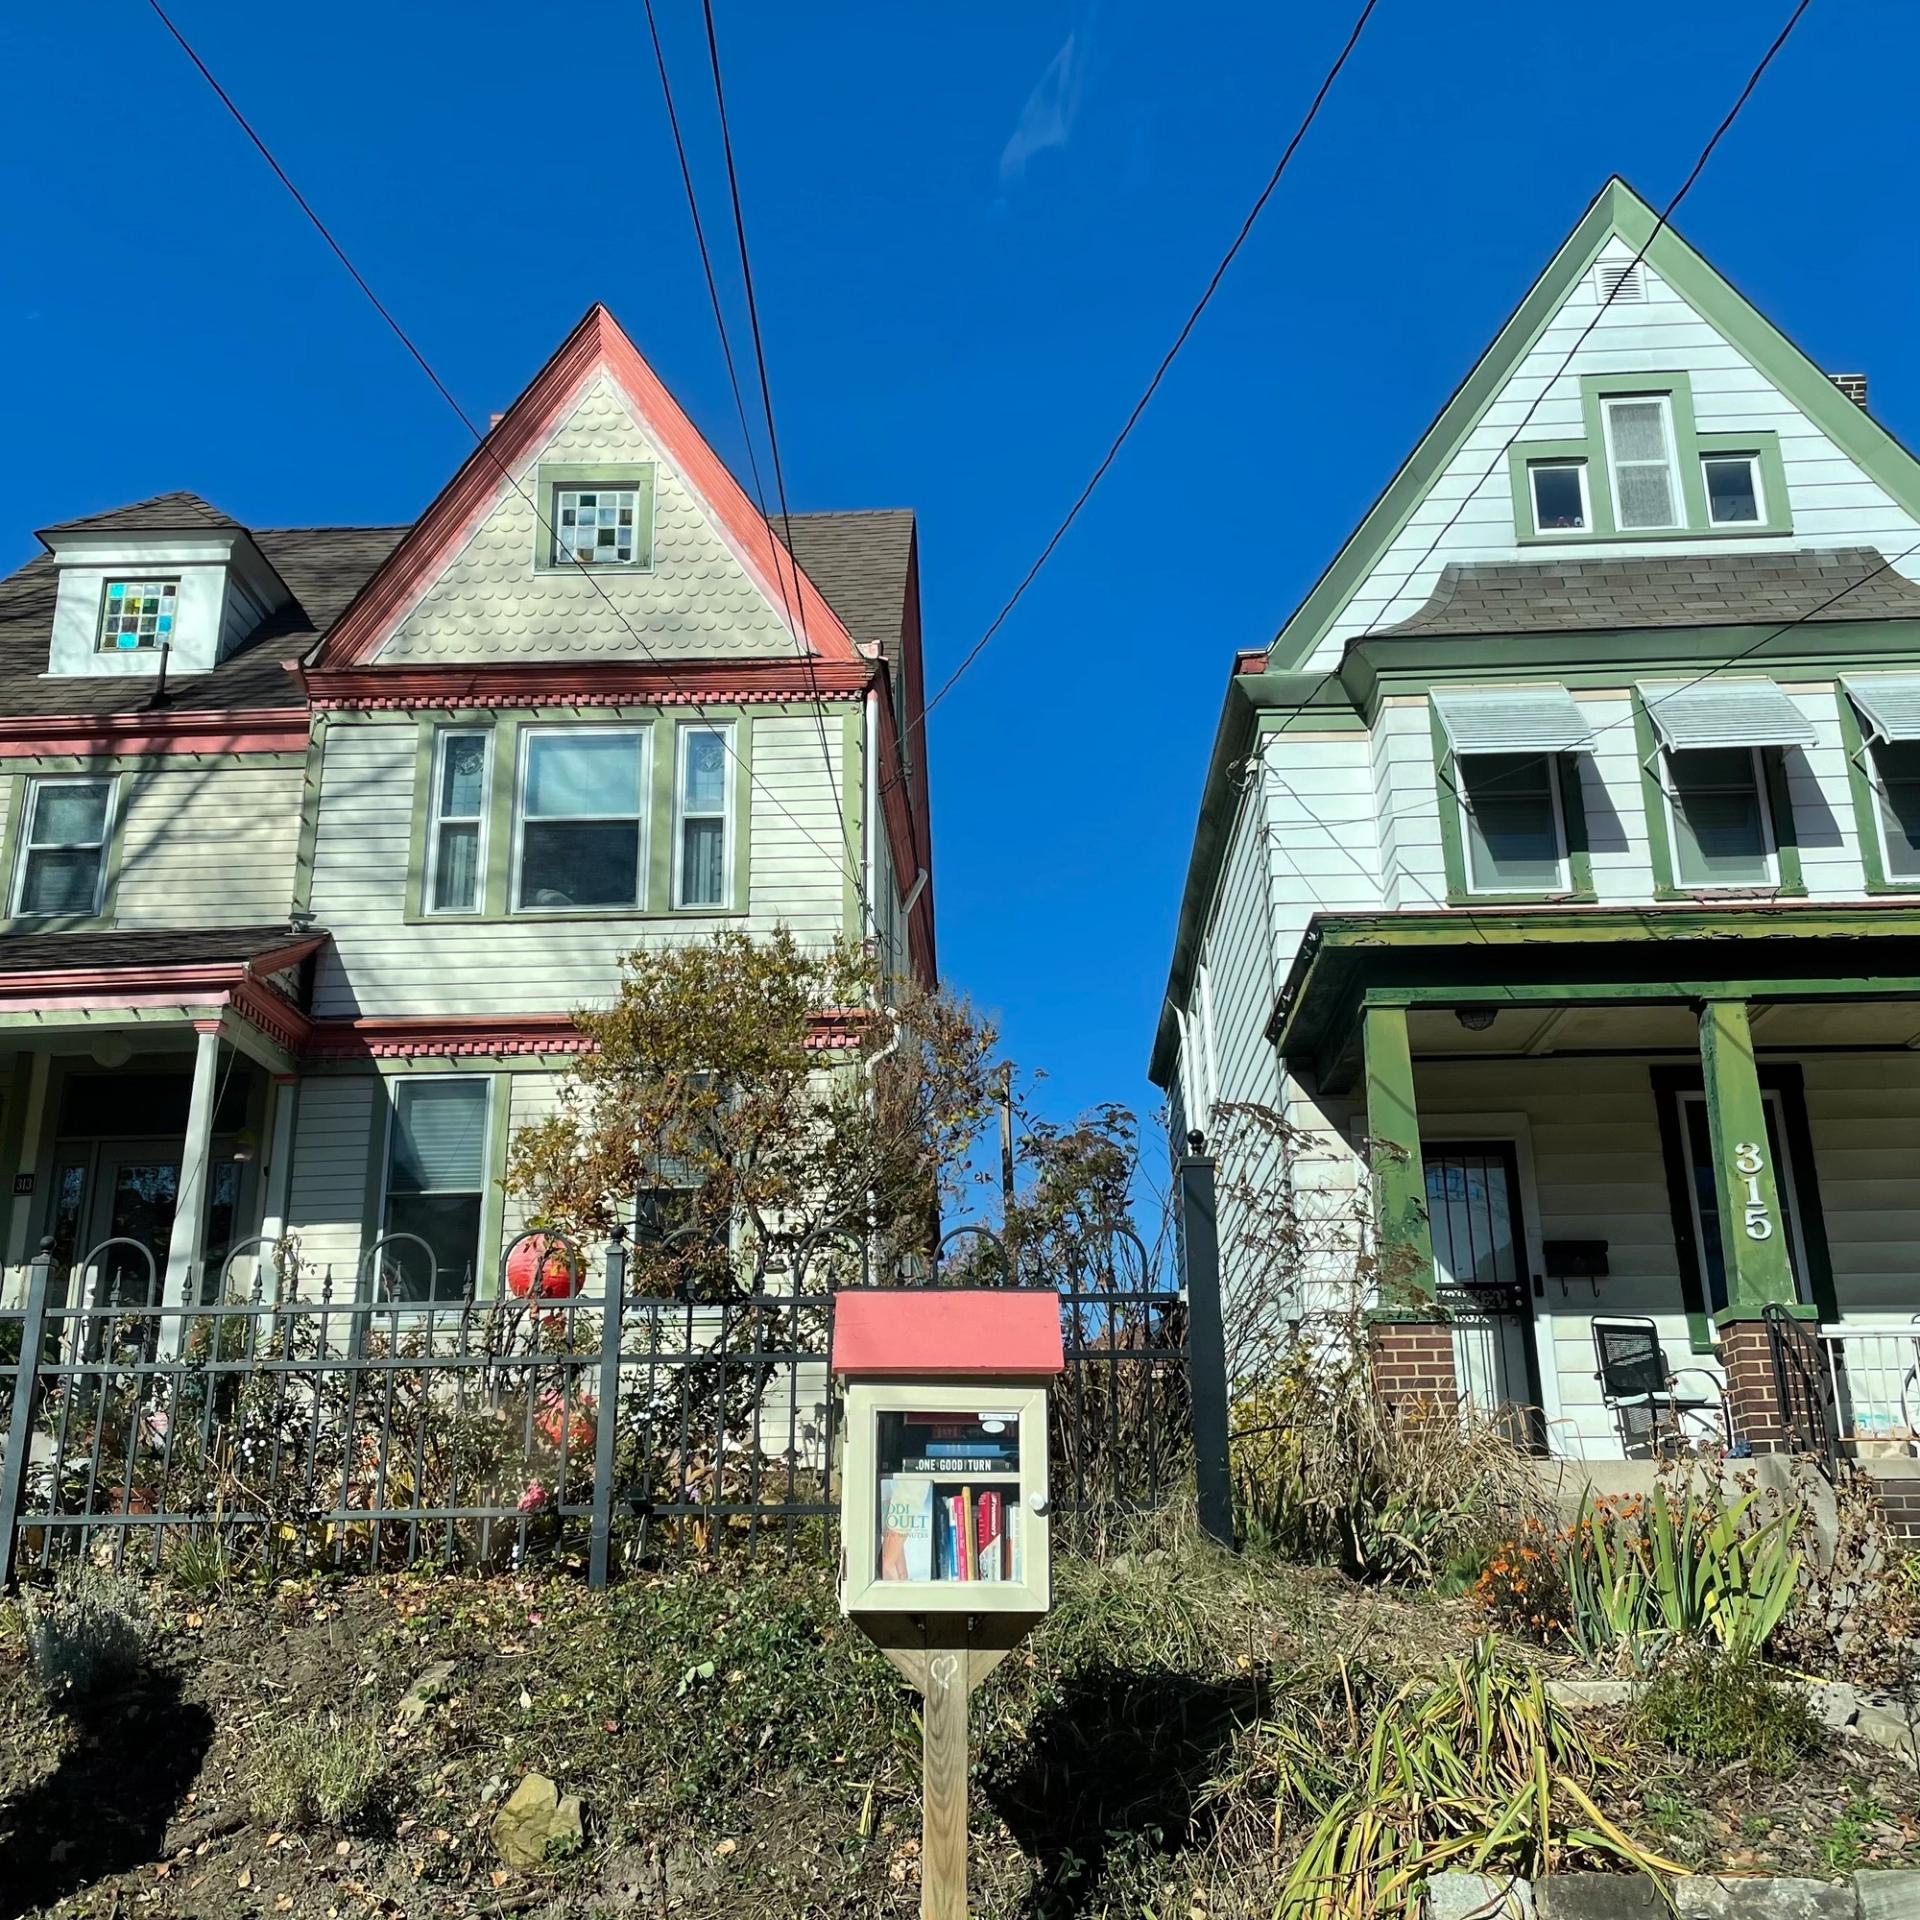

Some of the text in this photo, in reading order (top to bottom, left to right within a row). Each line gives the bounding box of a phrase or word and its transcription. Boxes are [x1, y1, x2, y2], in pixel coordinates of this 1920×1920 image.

[16, 1178, 32, 1191] 313
[1735, 1142, 1773, 1240] 315
[918, 1459, 991, 1472] ONE GOOD TURN
[887, 1504, 910, 1515] ODI
[885, 1515, 929, 1529] OULT
